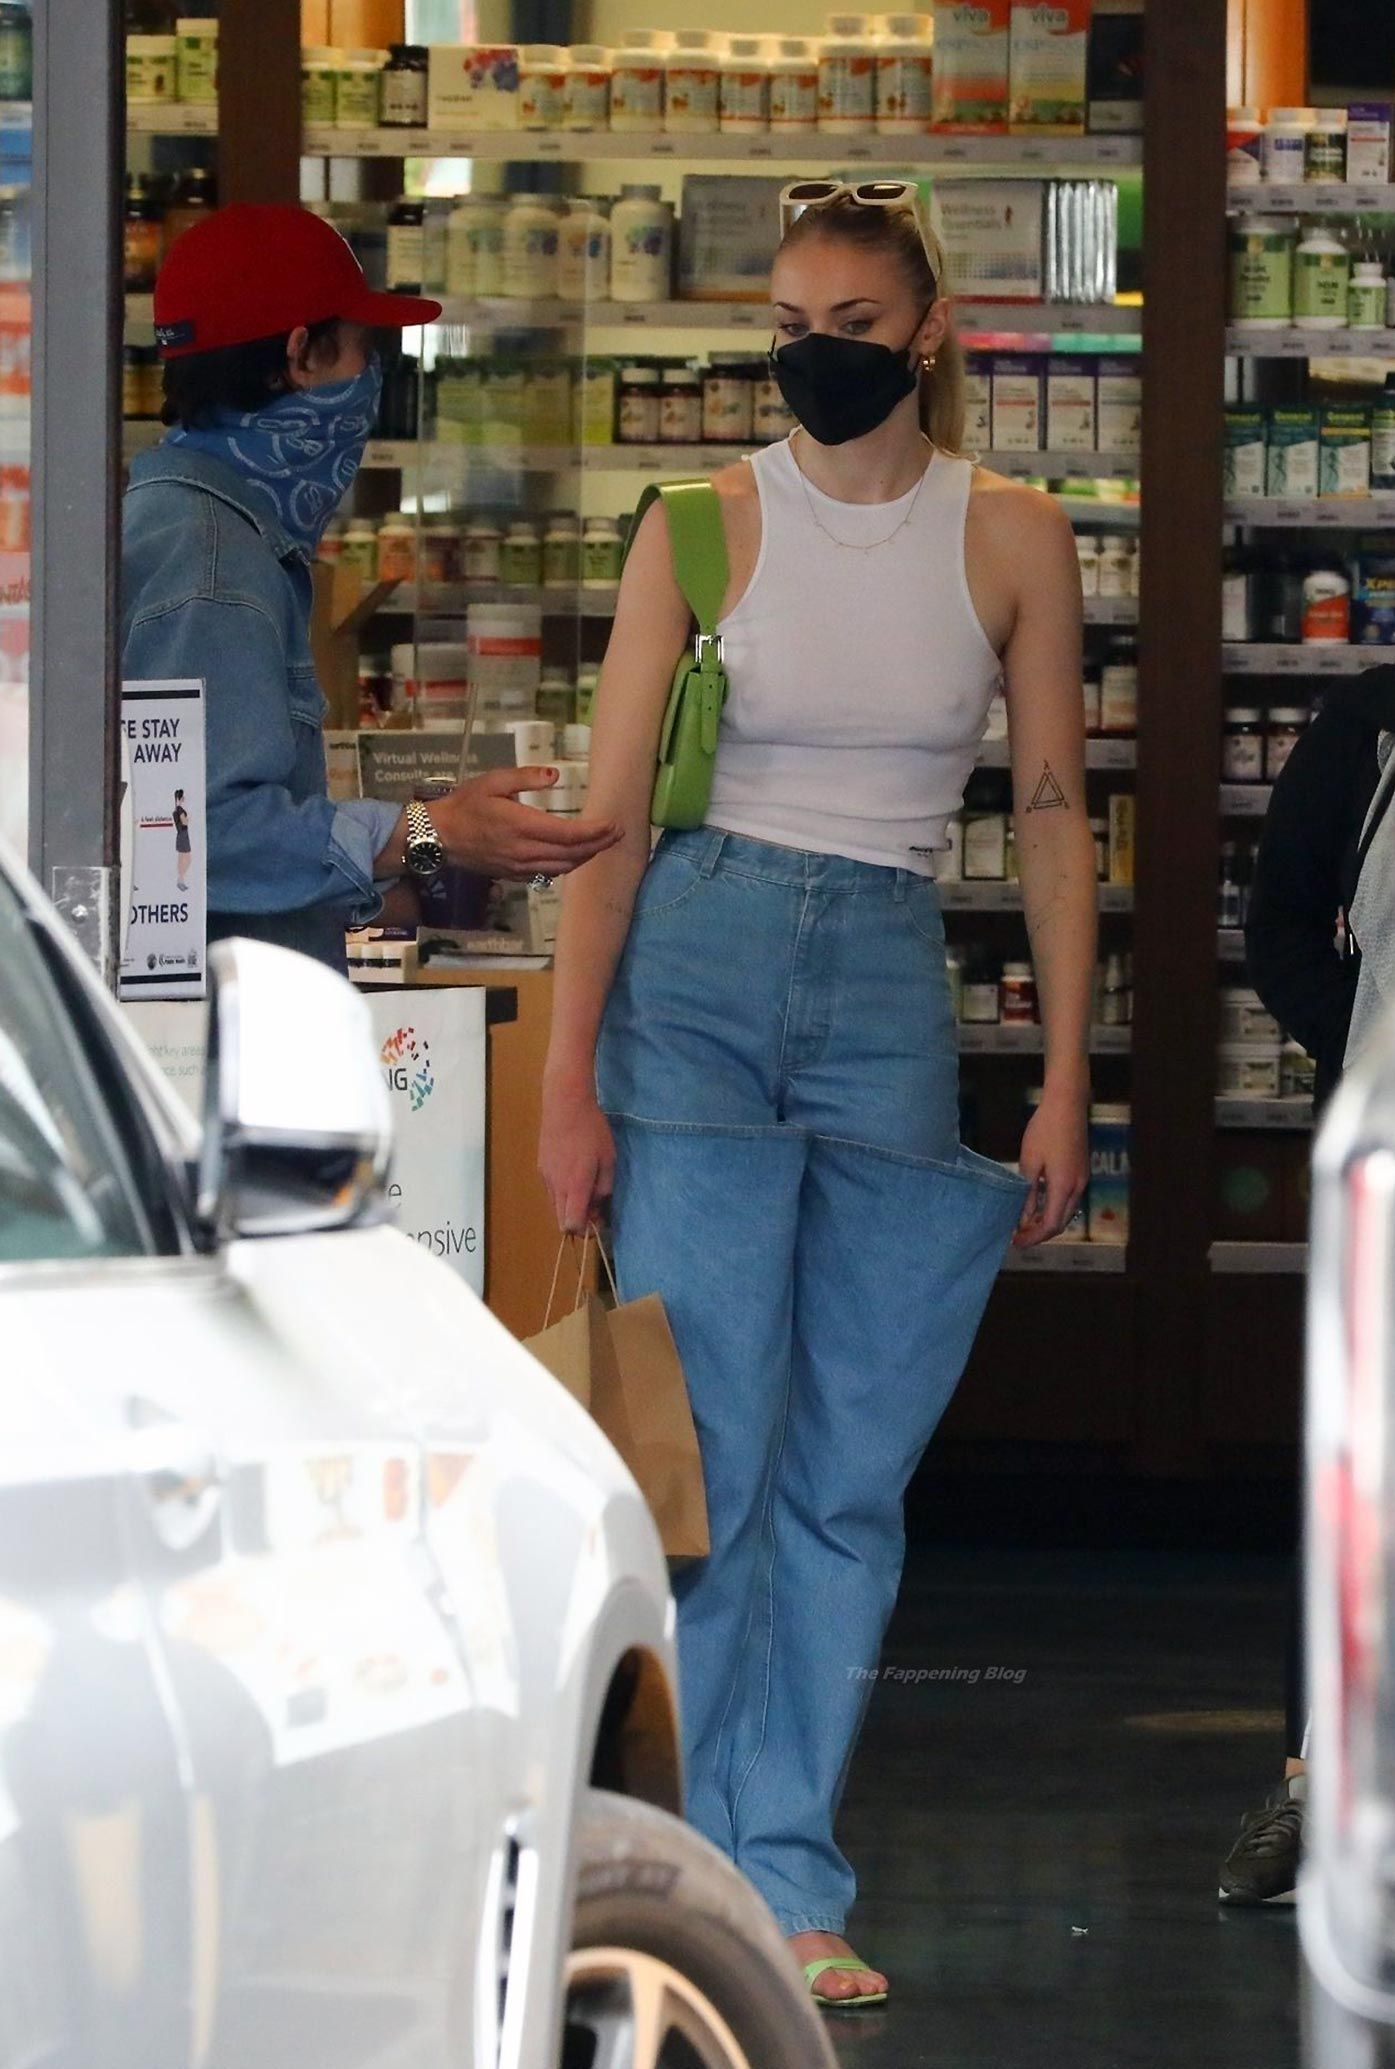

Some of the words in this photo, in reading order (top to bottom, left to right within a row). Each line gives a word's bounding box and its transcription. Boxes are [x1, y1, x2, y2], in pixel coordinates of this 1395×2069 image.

[142, 718, 180, 739] STAY
[134, 743, 182, 763] AWAY
[373, 751, 417, 765] Virtual
